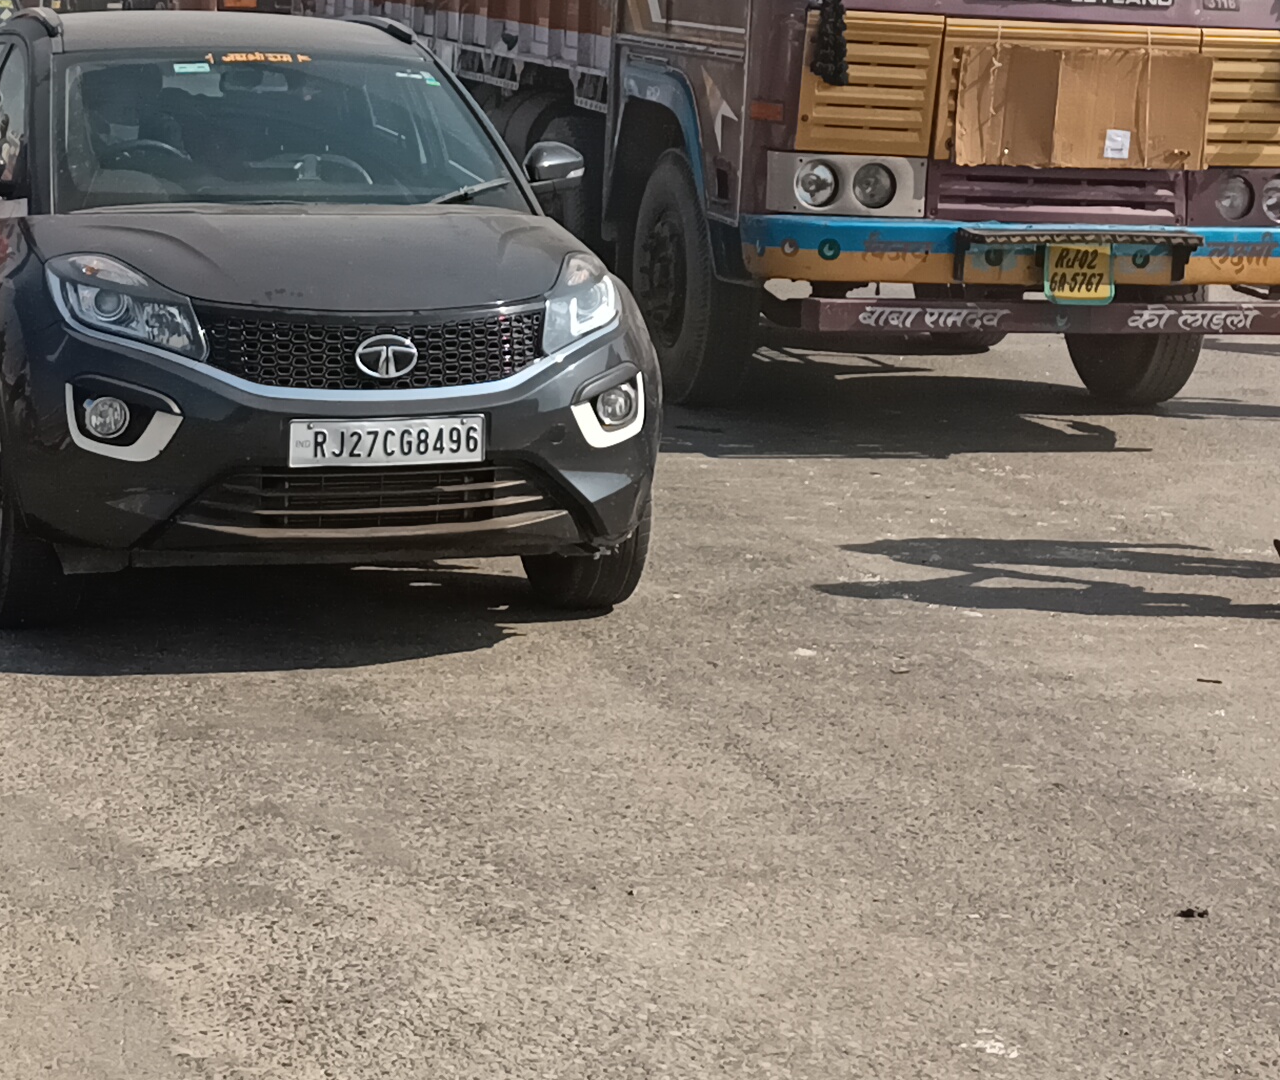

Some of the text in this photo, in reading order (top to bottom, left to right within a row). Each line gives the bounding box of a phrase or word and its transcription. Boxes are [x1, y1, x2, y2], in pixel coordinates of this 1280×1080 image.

[859, 306, 923, 329] बाबा
[924, 303, 1011, 332] रामदेव
[1128, 304, 1178, 330] की
[313, 426, 479, 458] RJ27CG8496
